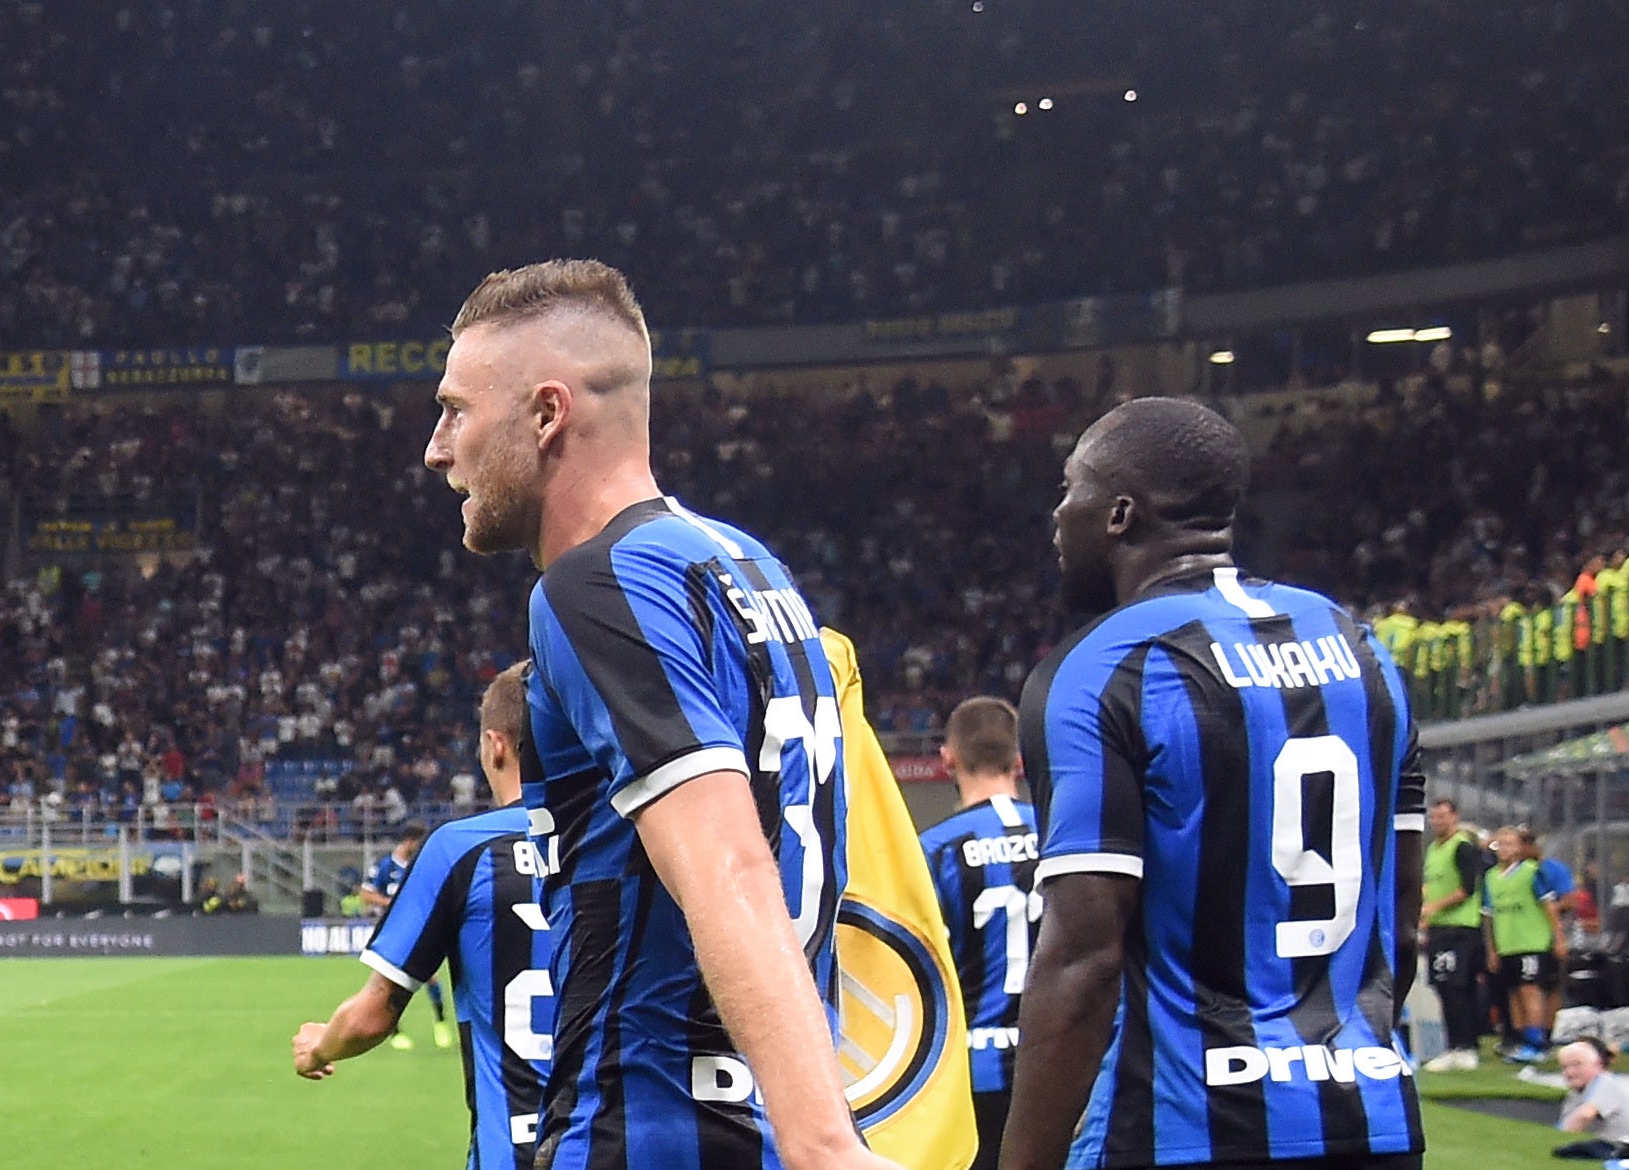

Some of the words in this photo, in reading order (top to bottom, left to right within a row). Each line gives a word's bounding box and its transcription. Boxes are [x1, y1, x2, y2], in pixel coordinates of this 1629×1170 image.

[1210, 633, 1362, 689] LUKAKU
[1273, 735, 1363, 958] 9
[31, 934, 65, 948] FOR
[68, 933, 155, 948] EVERYONE
